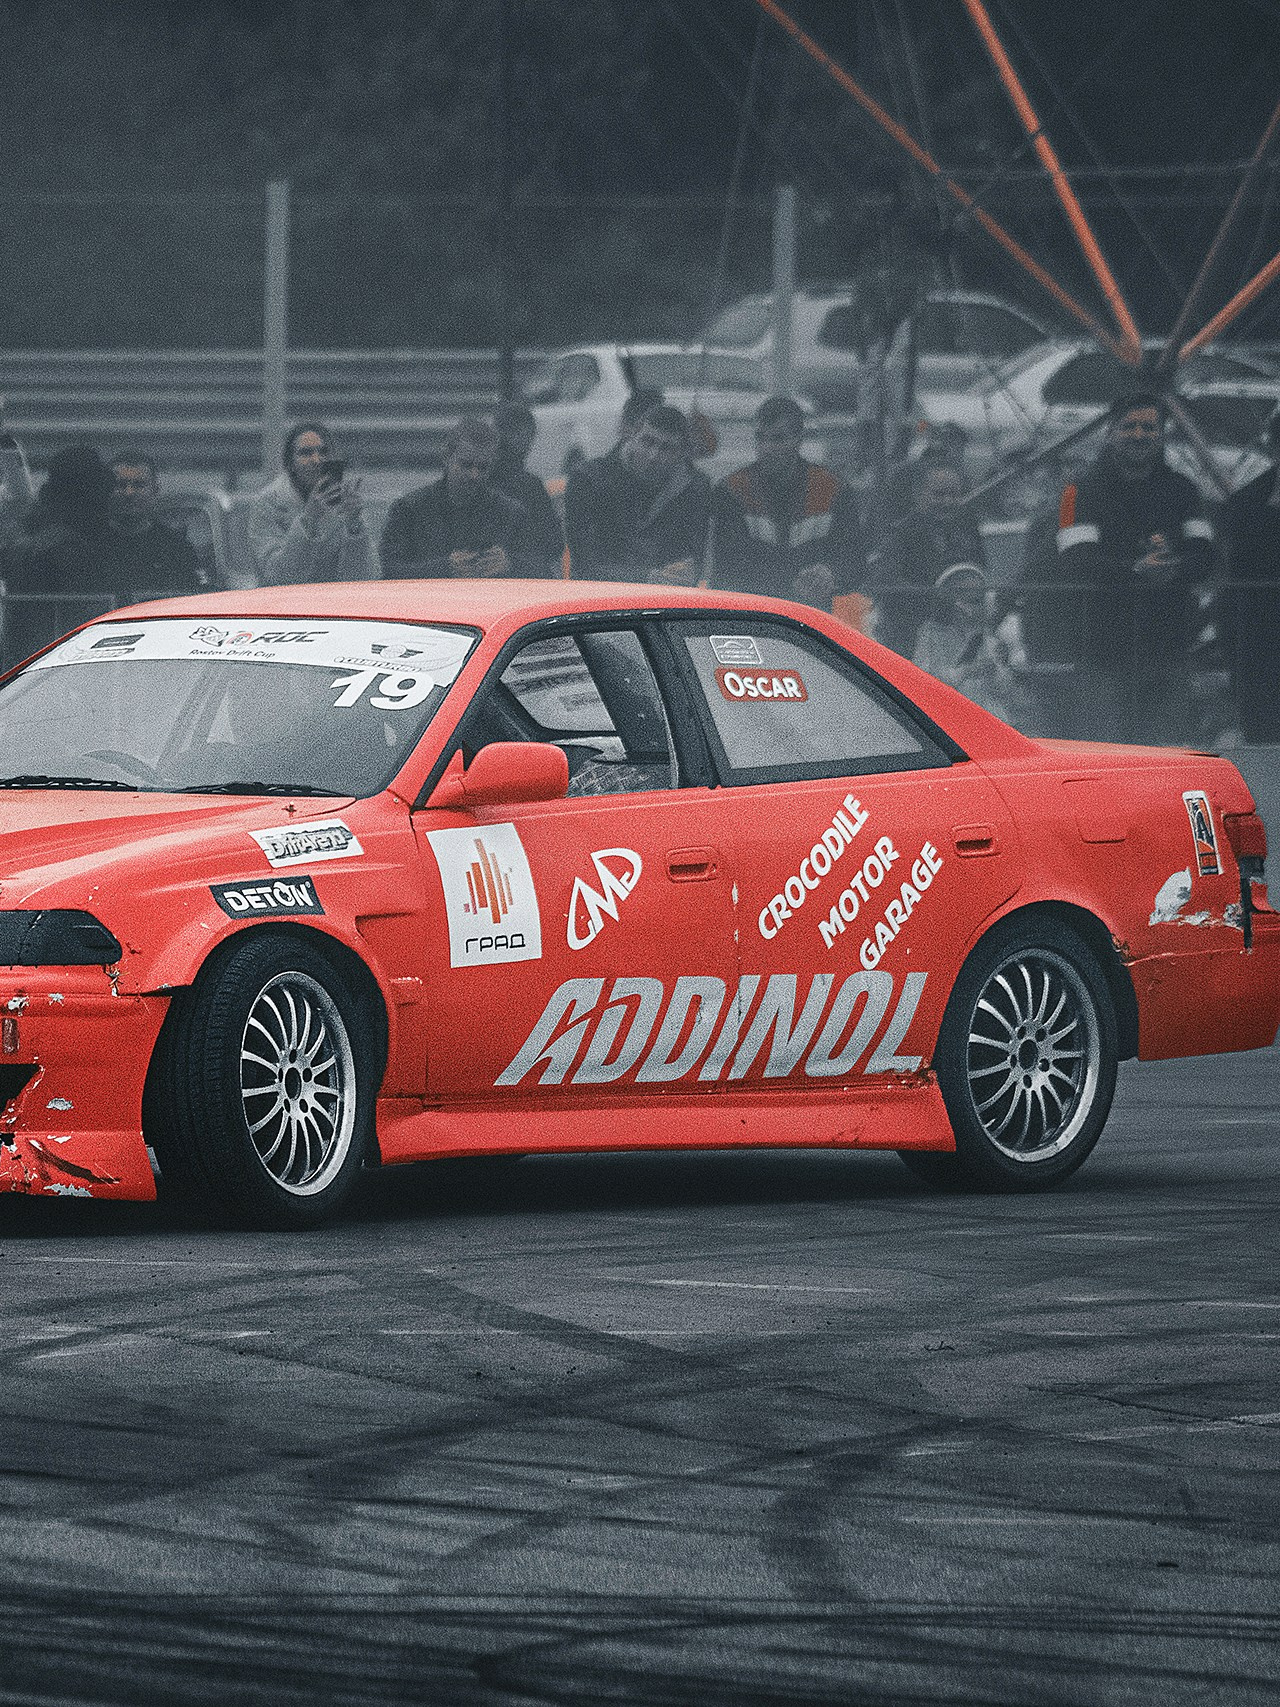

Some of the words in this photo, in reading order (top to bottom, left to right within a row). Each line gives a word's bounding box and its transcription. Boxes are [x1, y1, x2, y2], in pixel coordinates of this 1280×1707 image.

[188, 648, 224, 657] Rostov
[226, 649, 253, 658] Drift
[254, 650, 276, 659] Cup
[329, 667, 435, 711] 19
[758, 793, 870, 941] CROCODILE
[816, 835, 901, 950] MOTOR
[859, 841, 944, 971] GARAGE
[465, 933, 527, 954] ГРАД
[492, 970, 929, 1087] ADDINOL
